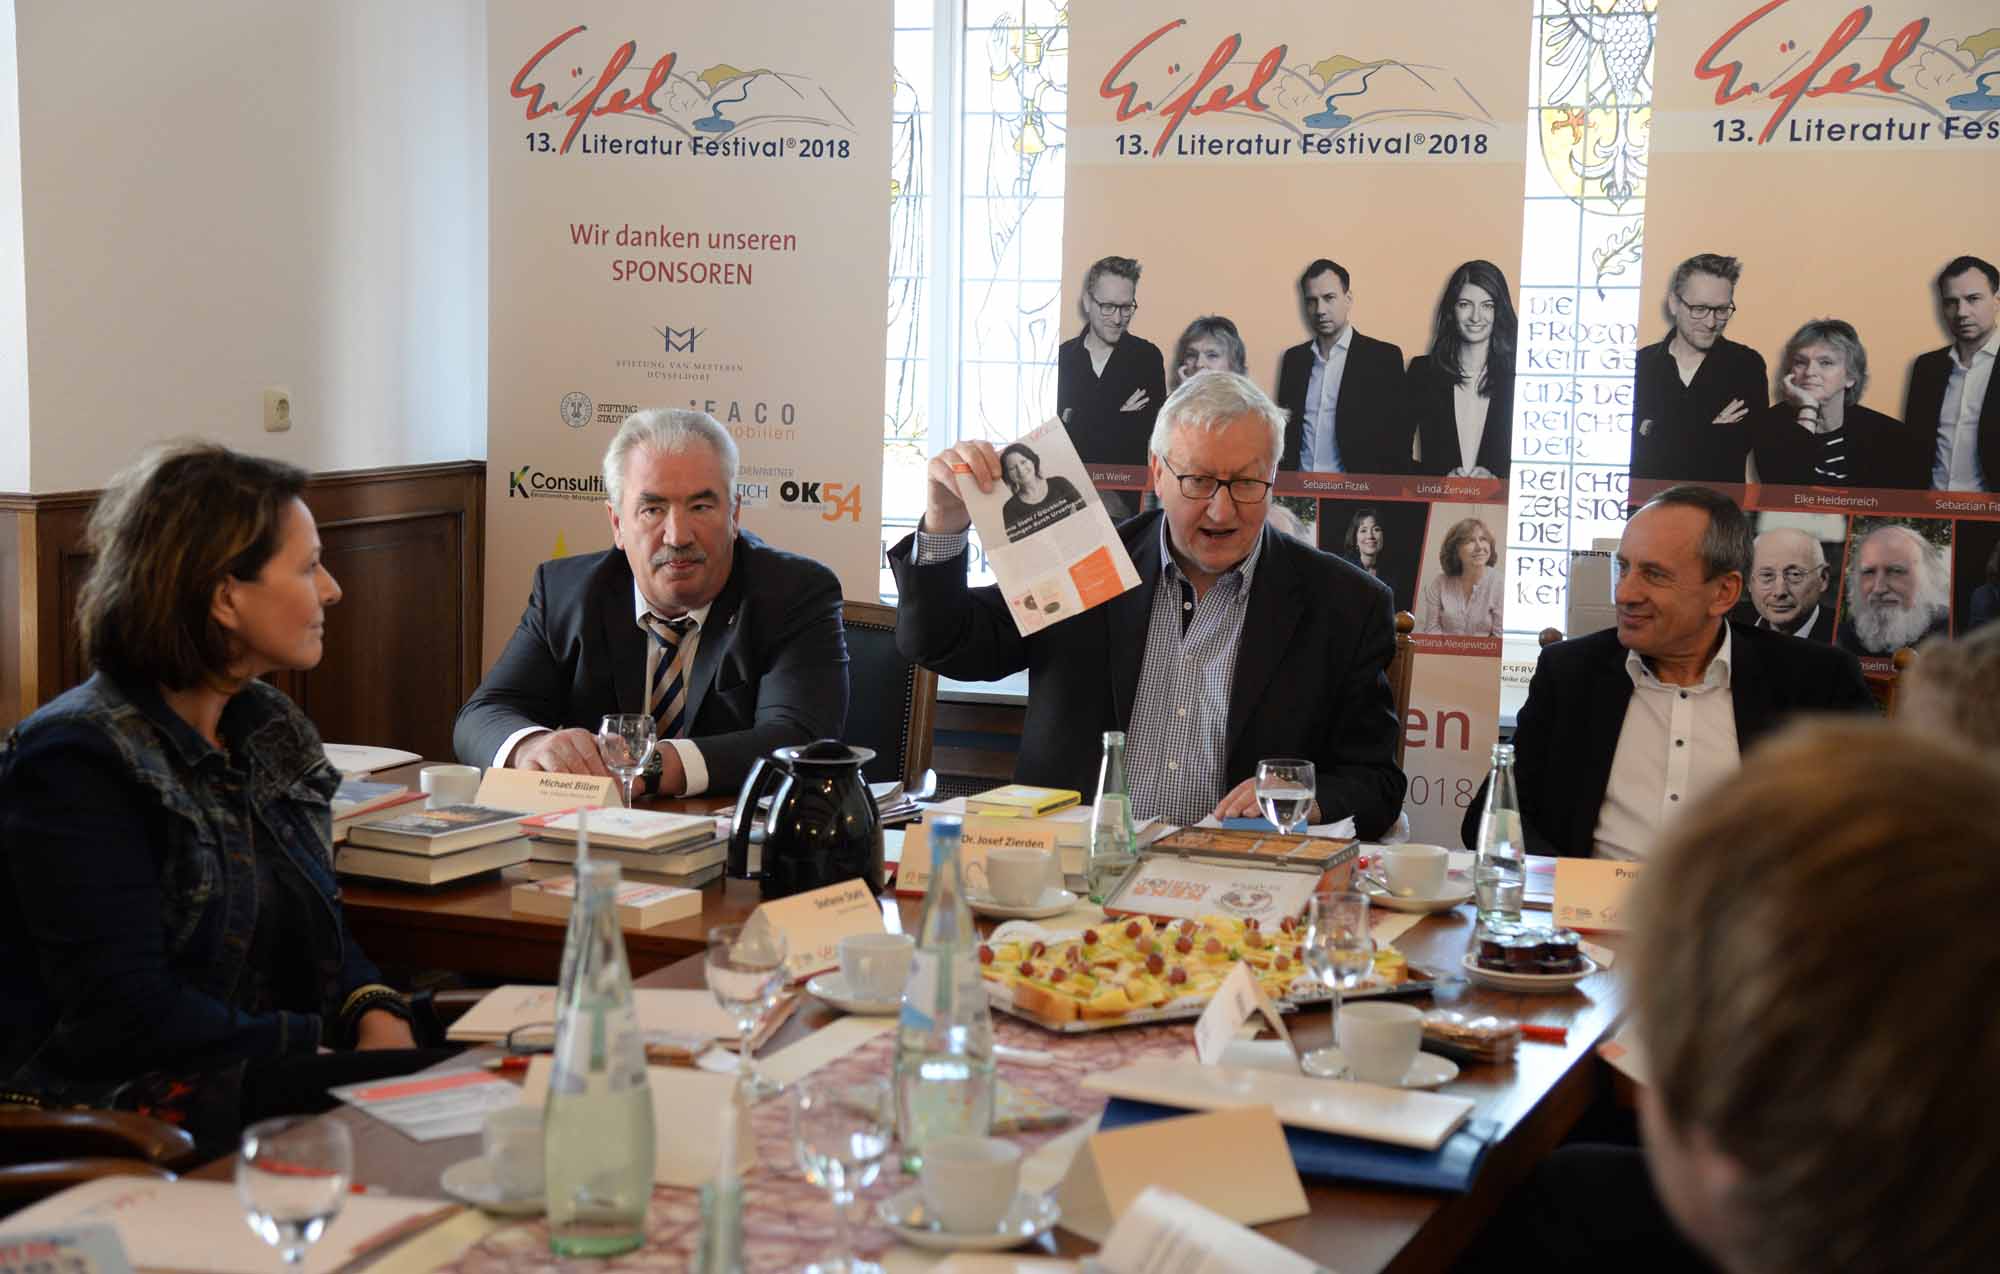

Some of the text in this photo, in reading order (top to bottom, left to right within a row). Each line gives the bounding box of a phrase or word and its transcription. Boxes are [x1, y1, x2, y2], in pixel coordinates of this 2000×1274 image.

[1713, 119, 1754, 142] 13.
[1789, 117, 1931, 142] Literatur
[525, 132, 557, 153] 13.
[582, 134, 682, 156] Literatur
[799, 138, 851, 158] 2018
[1114, 134, 1149, 155] 13.
[1177, 134, 1291, 155] Literatur
[1428, 134, 1488, 155] 2018
[570, 223, 797, 251] Wir danken unseren
[612, 260, 753, 285] SPONSOREN
[1530, 296, 1573, 315] DIE
[596, 403, 638, 413] STIFTUNG
[1303, 479, 1370, 491] Sebastian Fitzek
[1416, 484, 1441, 495] Linda
[1794, 494, 1879, 507] Elke Heidenreich
[1935, 499, 1986, 511] Sebastian
[1518, 521, 1564, 543] DIE
[539, 778, 600, 792] Michael Billen
[961, 834, 1045, 849] Dr. Josef Zierden
